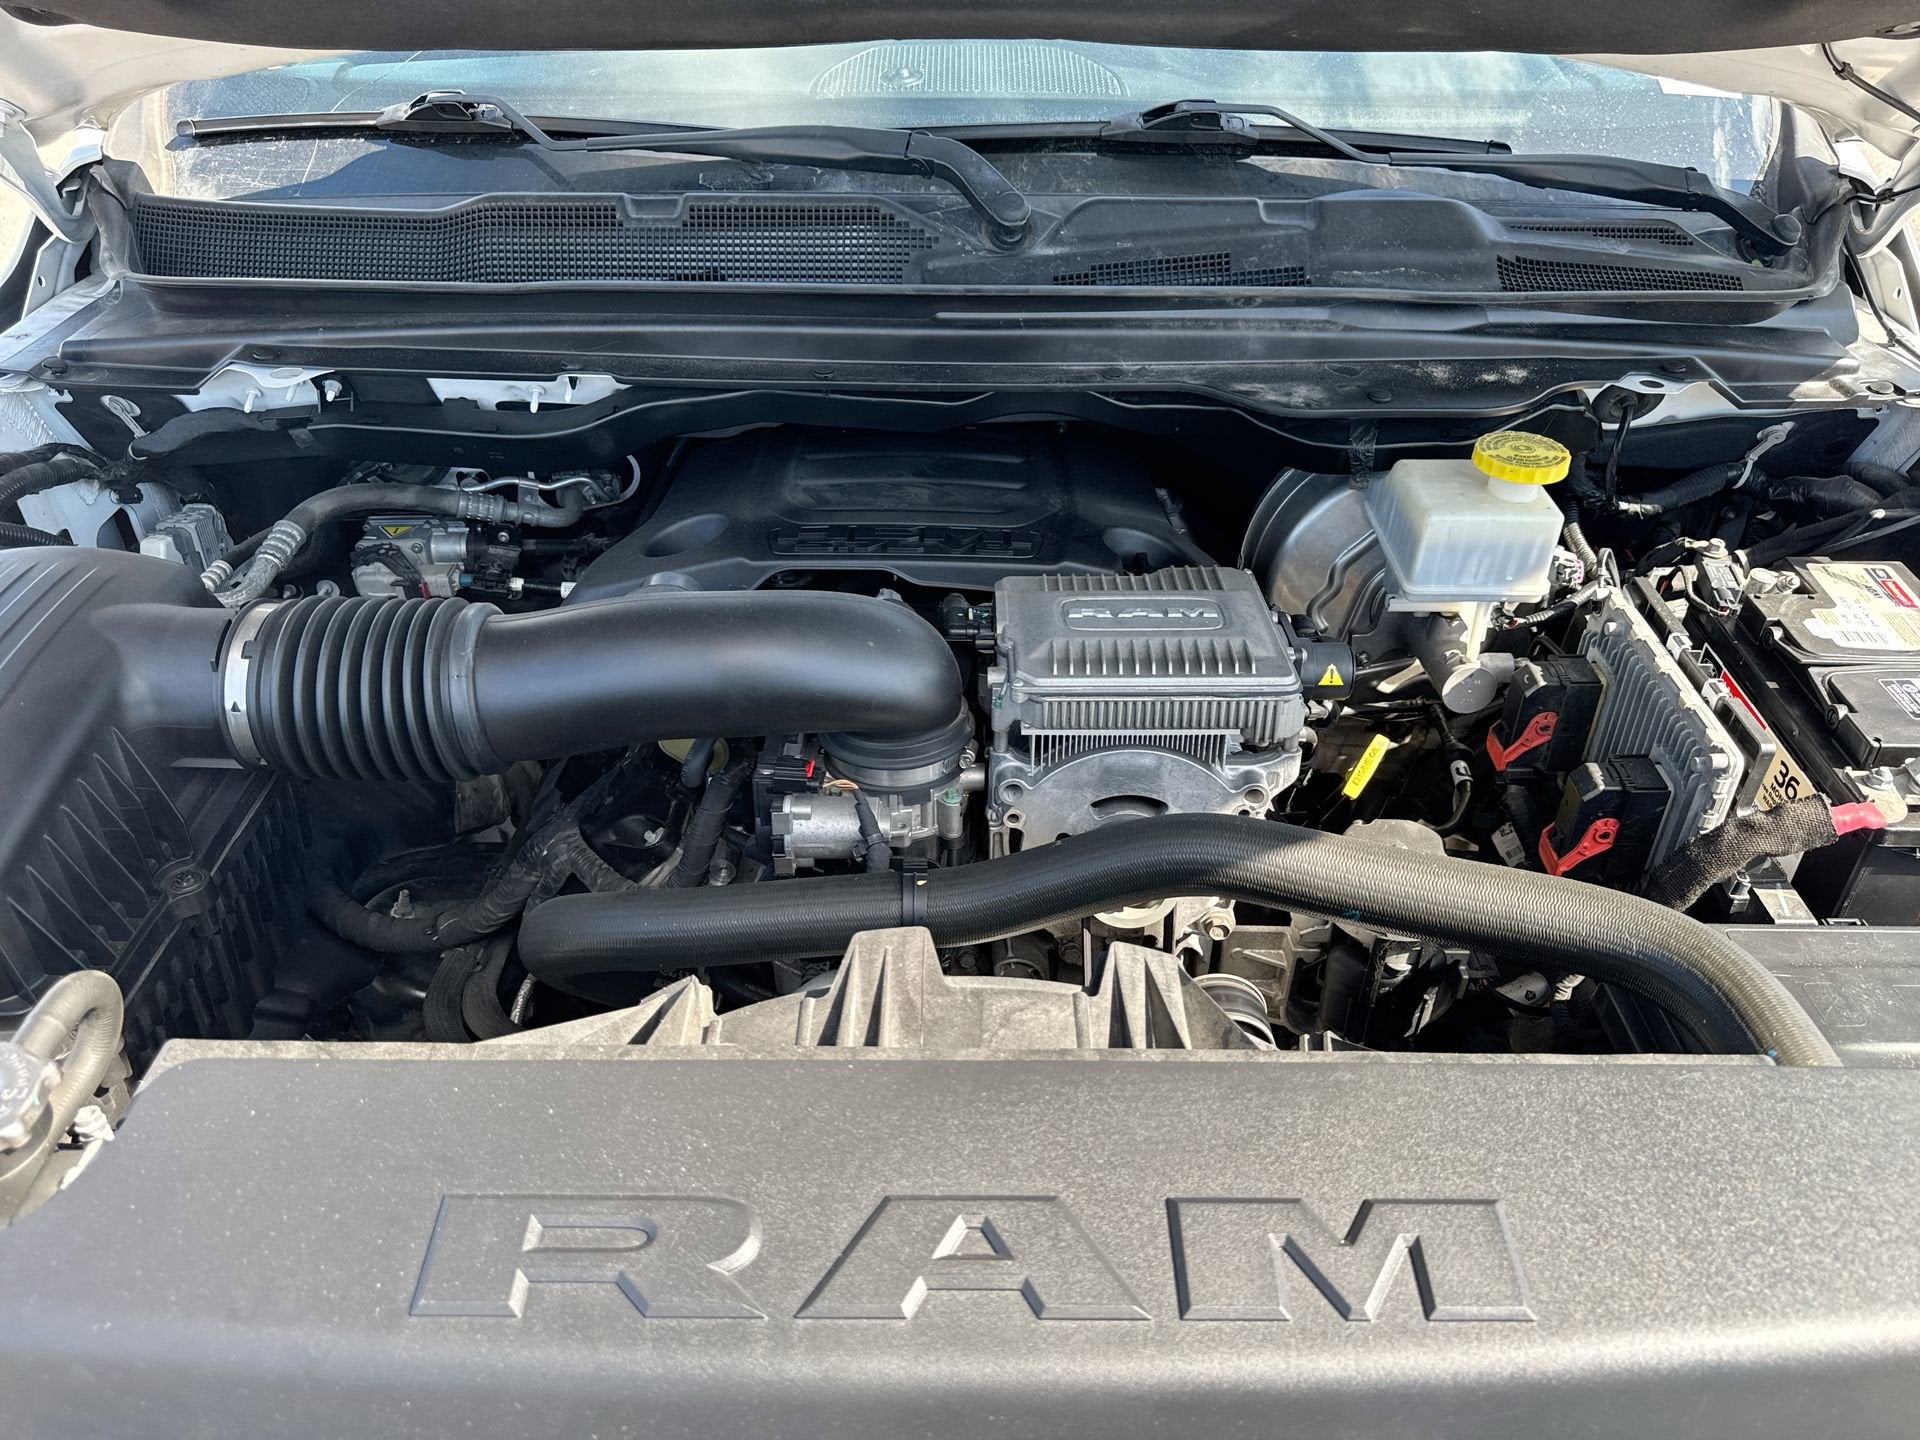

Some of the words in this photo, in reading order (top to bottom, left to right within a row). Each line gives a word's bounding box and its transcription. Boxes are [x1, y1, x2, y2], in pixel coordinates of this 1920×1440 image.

[1067, 607, 1219, 619] RAM
[1774, 760, 1800, 800] 36
[409, 1195, 1538, 1323] RAM
